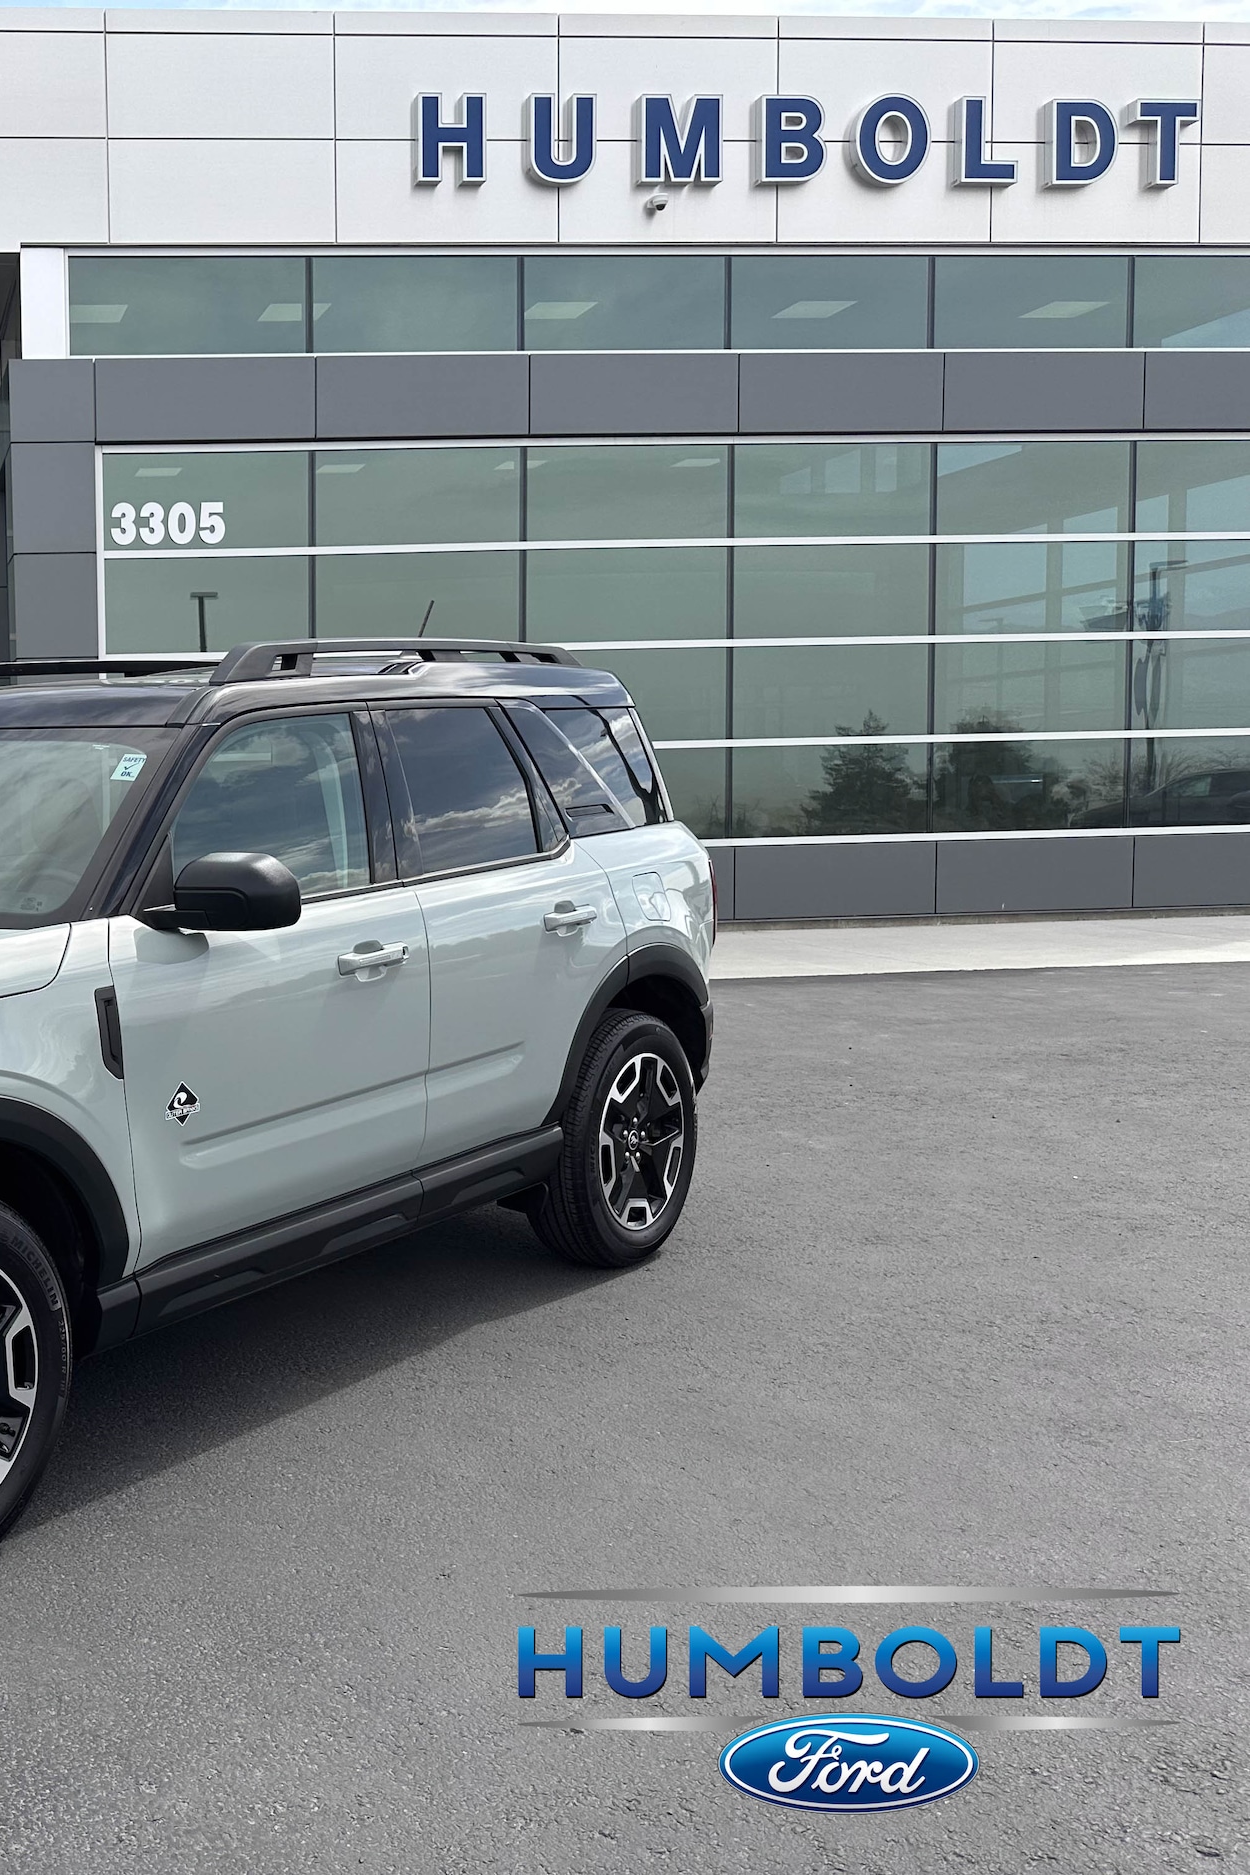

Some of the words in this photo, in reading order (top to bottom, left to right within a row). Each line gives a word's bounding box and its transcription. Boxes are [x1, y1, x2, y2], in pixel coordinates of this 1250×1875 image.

[415, 91, 1201, 188] HUMBOLDT
[110, 501, 226, 546] 3305
[11, 1235, 59, 1306] MICHELIN
